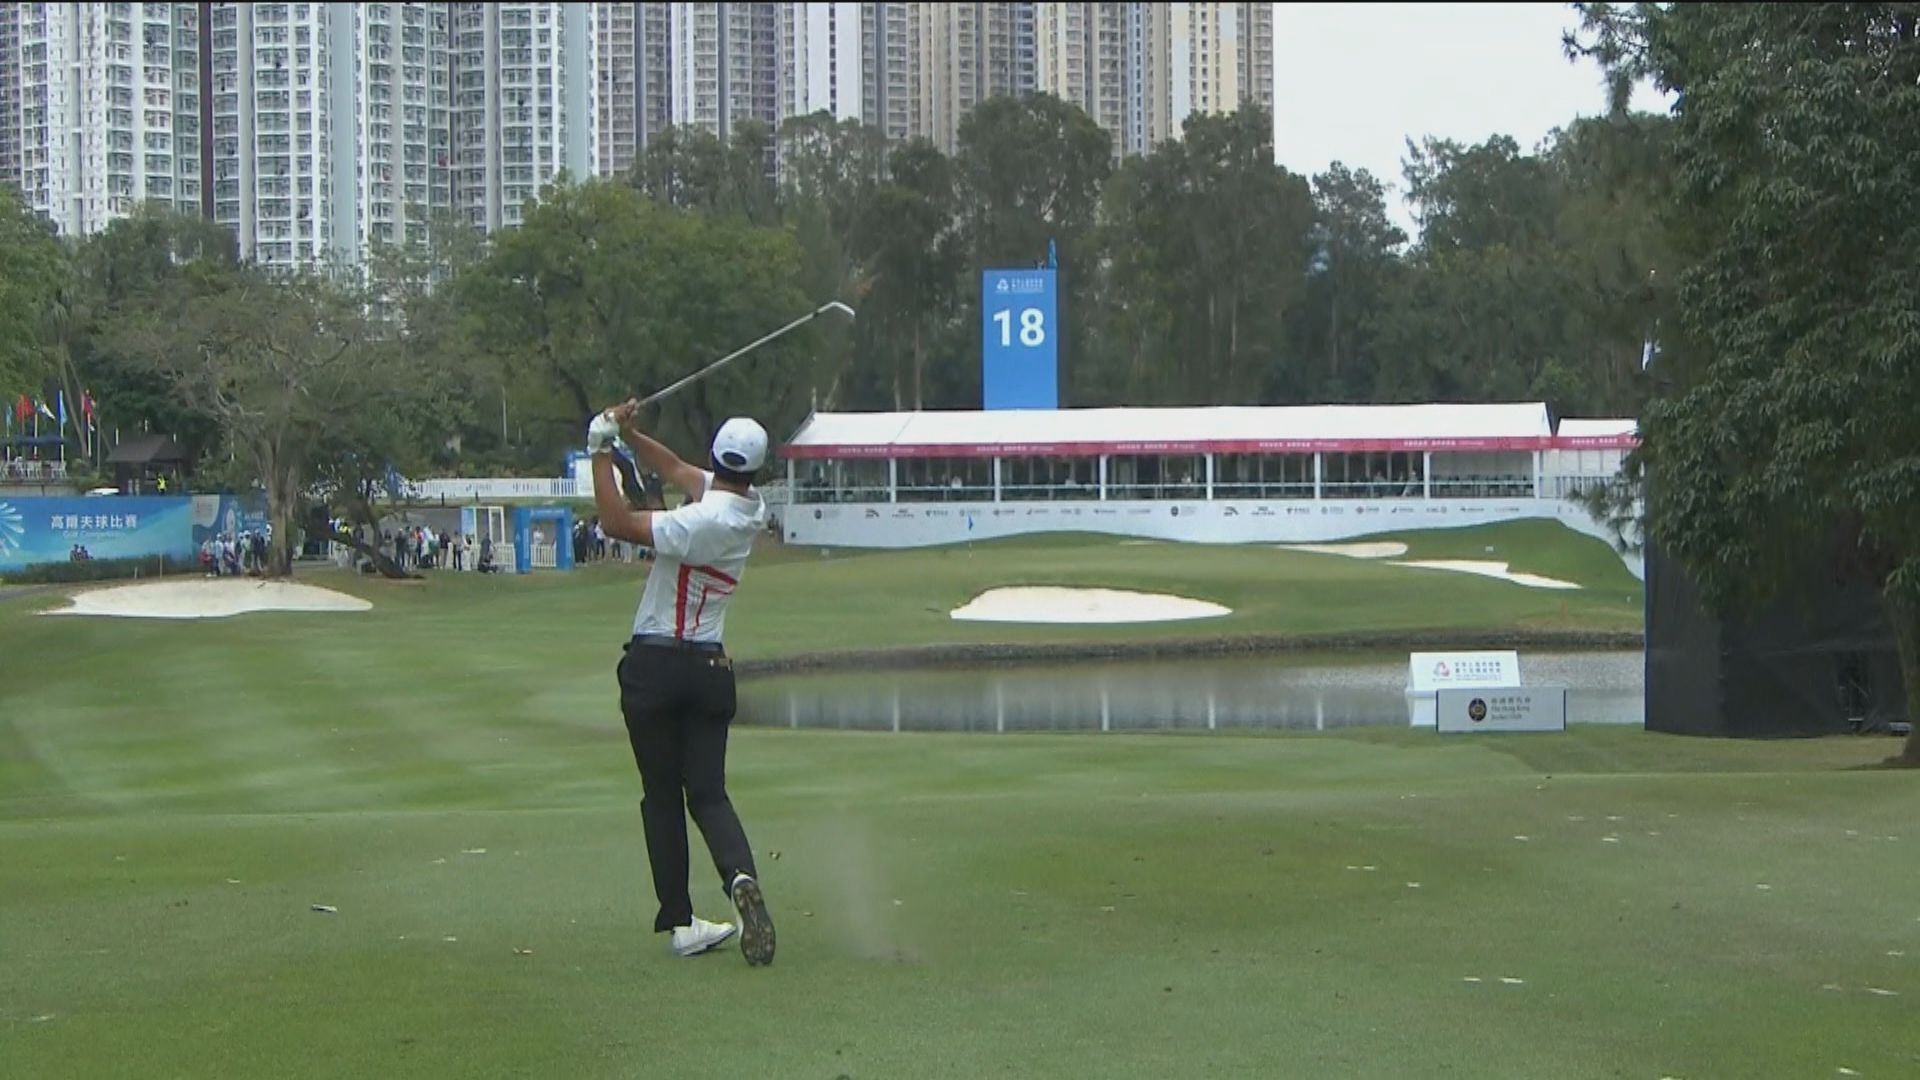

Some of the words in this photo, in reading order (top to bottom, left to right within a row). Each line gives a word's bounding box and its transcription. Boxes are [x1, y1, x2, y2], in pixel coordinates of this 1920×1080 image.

[993, 307, 1045, 347] 18
[51, 514, 138, 529] 高爾夫球比賽
